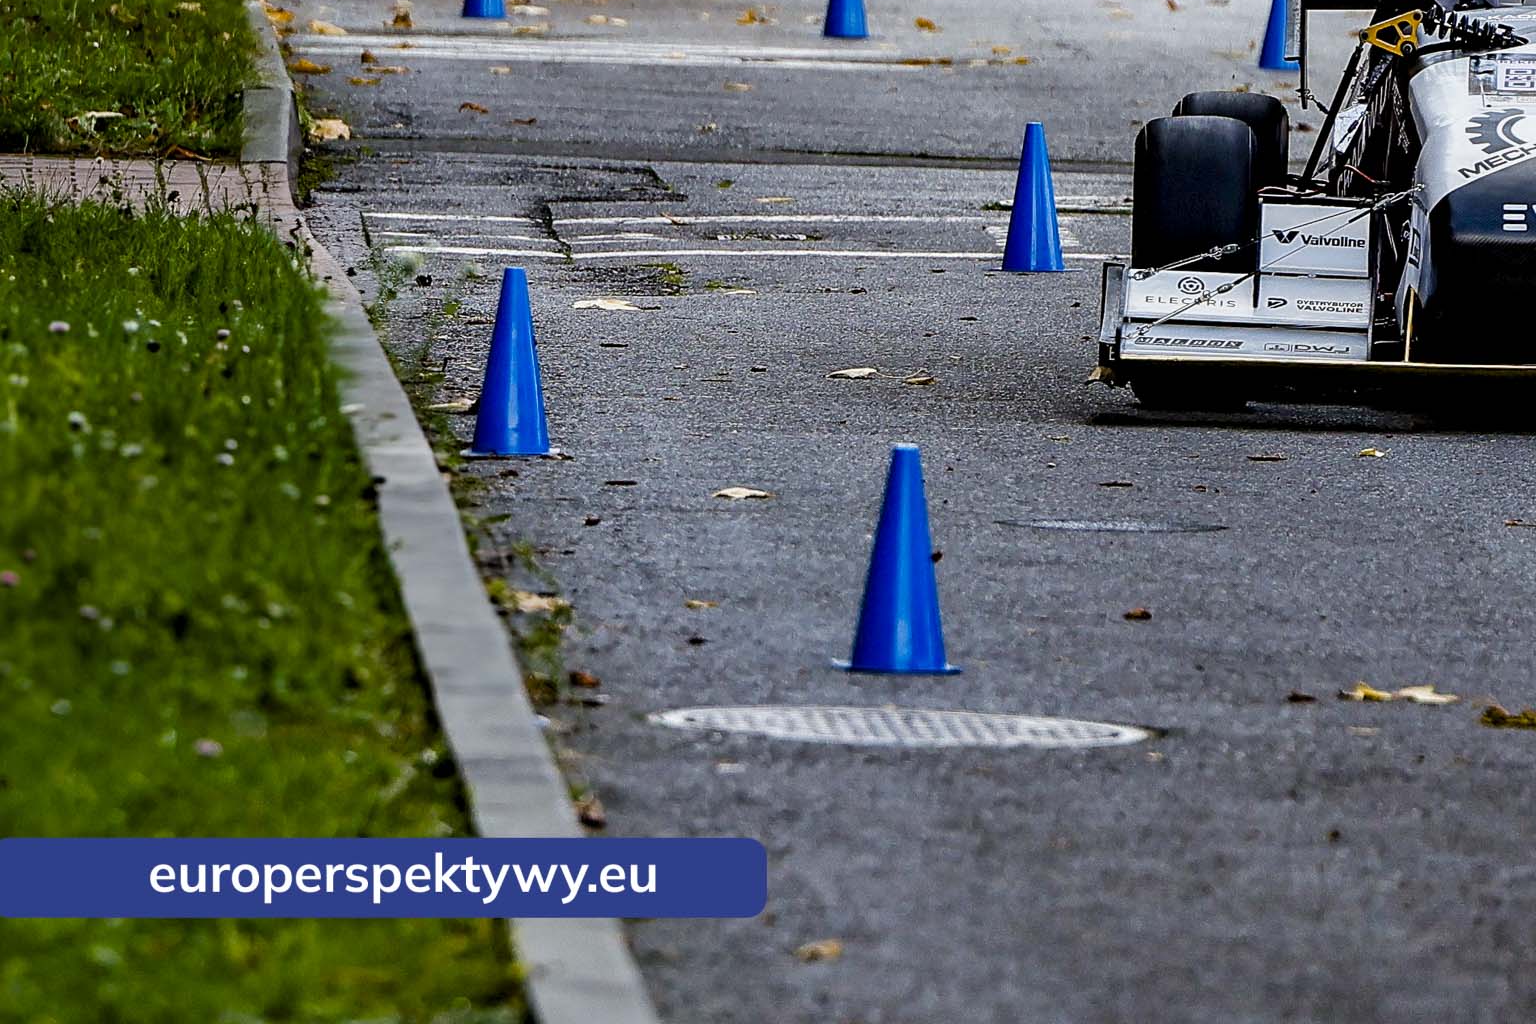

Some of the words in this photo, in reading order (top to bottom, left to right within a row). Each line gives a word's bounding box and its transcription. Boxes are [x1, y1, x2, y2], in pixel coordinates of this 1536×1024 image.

[1301, 234, 1366, 249] Valvoline
[1145, 295, 1237, 308] ELECRIS
[1296, 299, 1364, 308] DYSTRYBUTOR
[1296, 305, 1364, 314] VALVOLINE
[1294, 344, 1351, 354] DWJ
